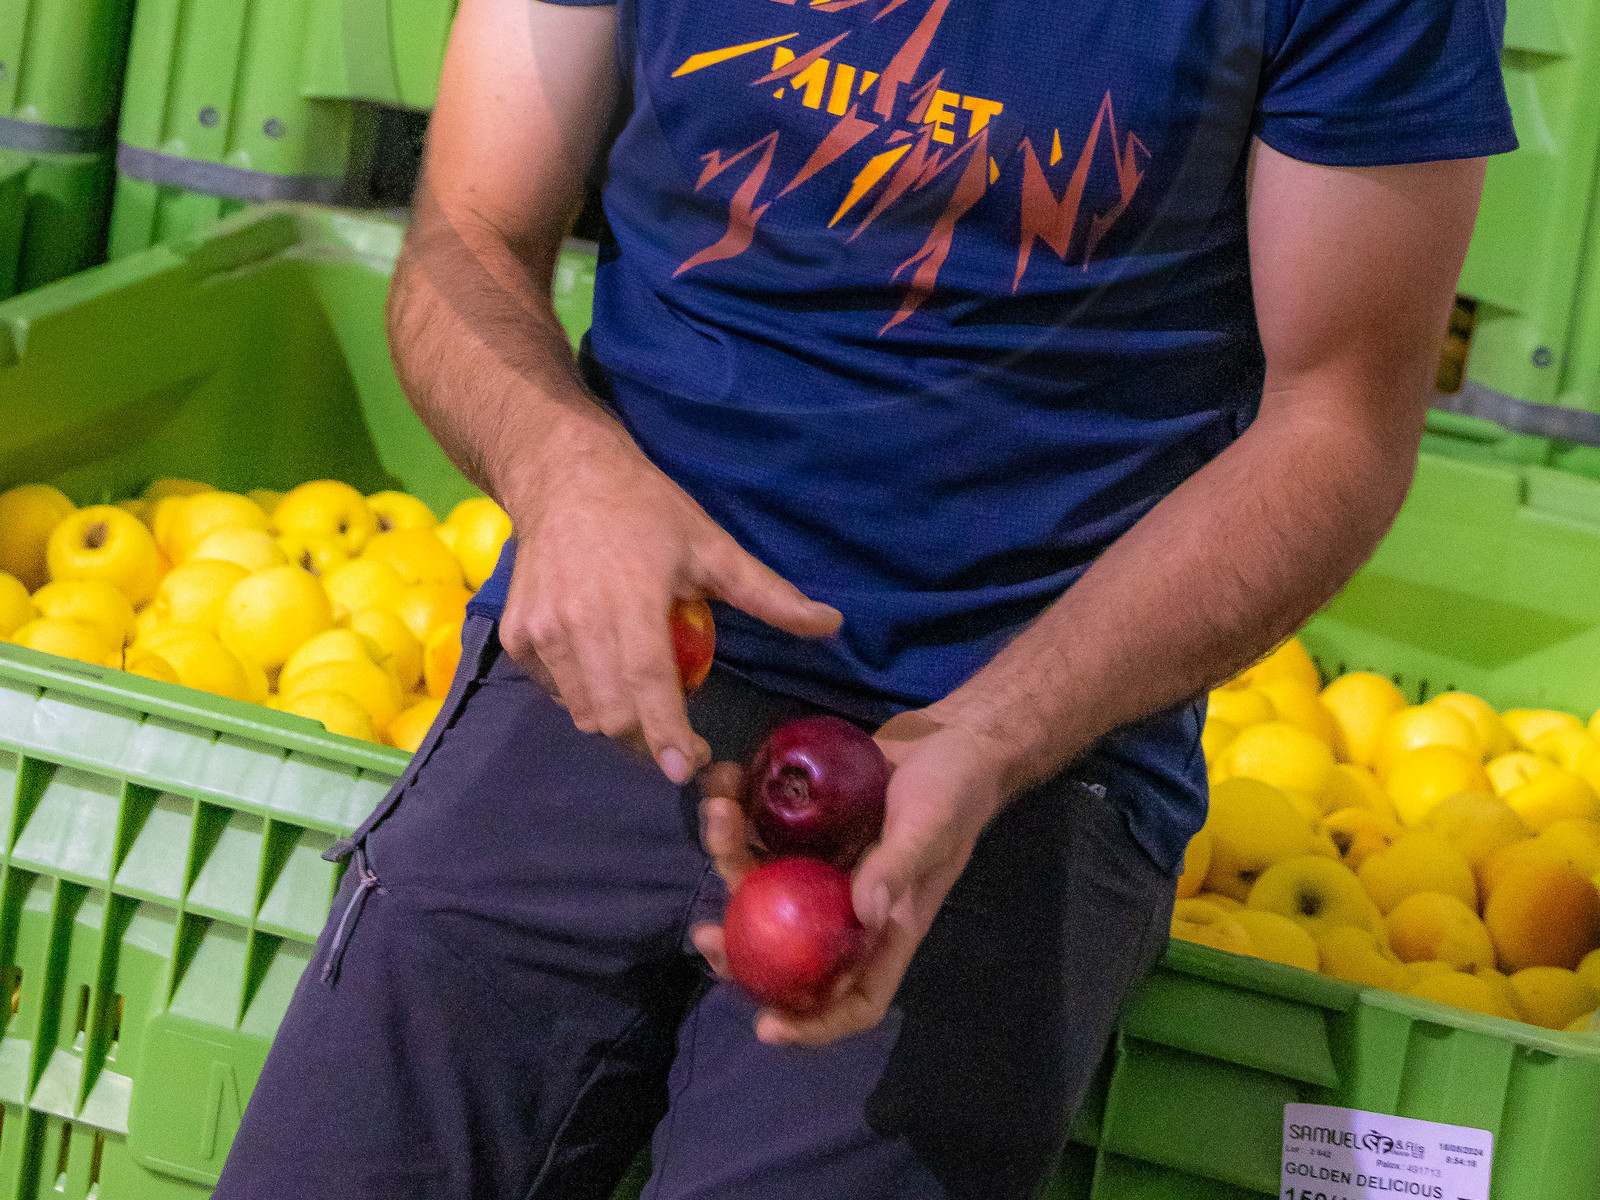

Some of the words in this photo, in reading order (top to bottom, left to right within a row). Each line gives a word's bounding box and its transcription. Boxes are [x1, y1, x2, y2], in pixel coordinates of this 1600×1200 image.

[772, 46, 1003, 144] MIET
[1289, 1124, 1362, 1150] SAMUEL
[1285, 1162, 1351, 1184] GOLDEN
[1356, 1174, 1442, 1199] DELICIOUS
